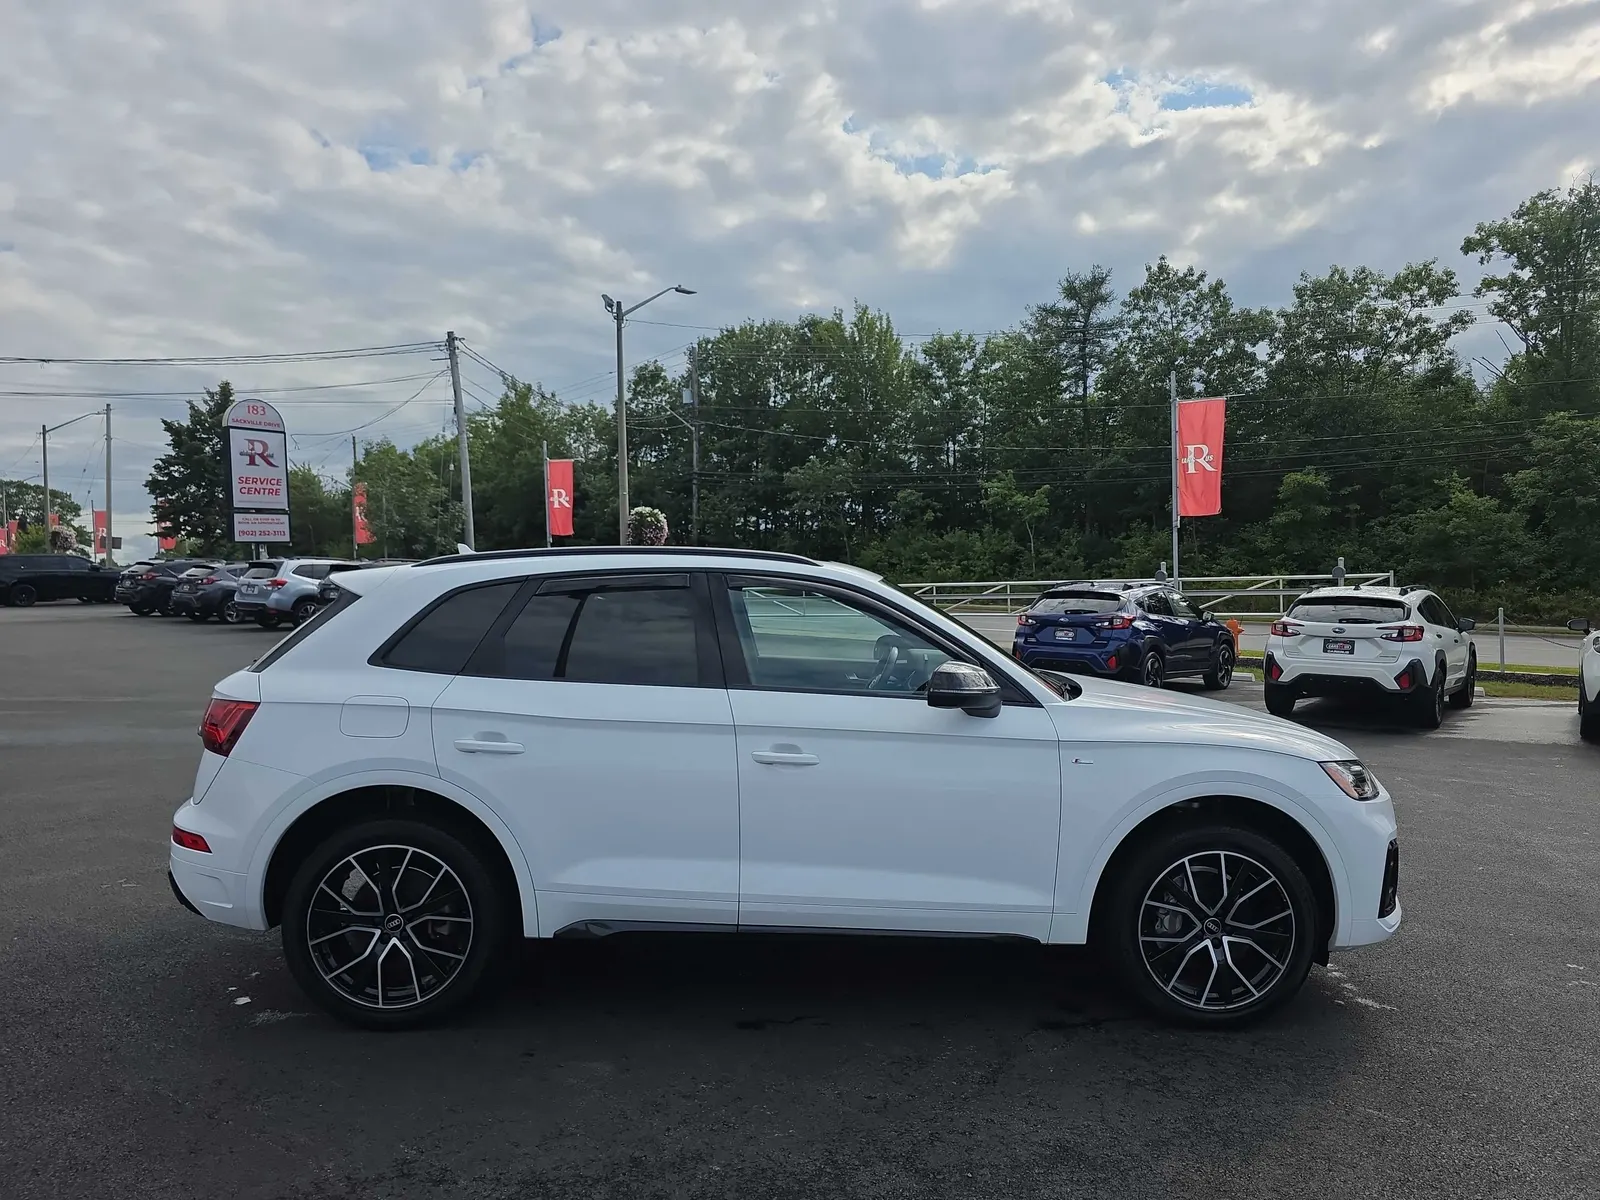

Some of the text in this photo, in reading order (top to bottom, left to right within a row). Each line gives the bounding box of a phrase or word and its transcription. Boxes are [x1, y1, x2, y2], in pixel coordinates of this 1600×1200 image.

[247, 405, 266, 415] 183
[244, 438, 279, 468] R
[1184, 444, 1218, 474] R
[238, 476, 282, 486] SERVICE
[239, 486, 281, 496] CENTRE
[551, 488, 571, 509] R
